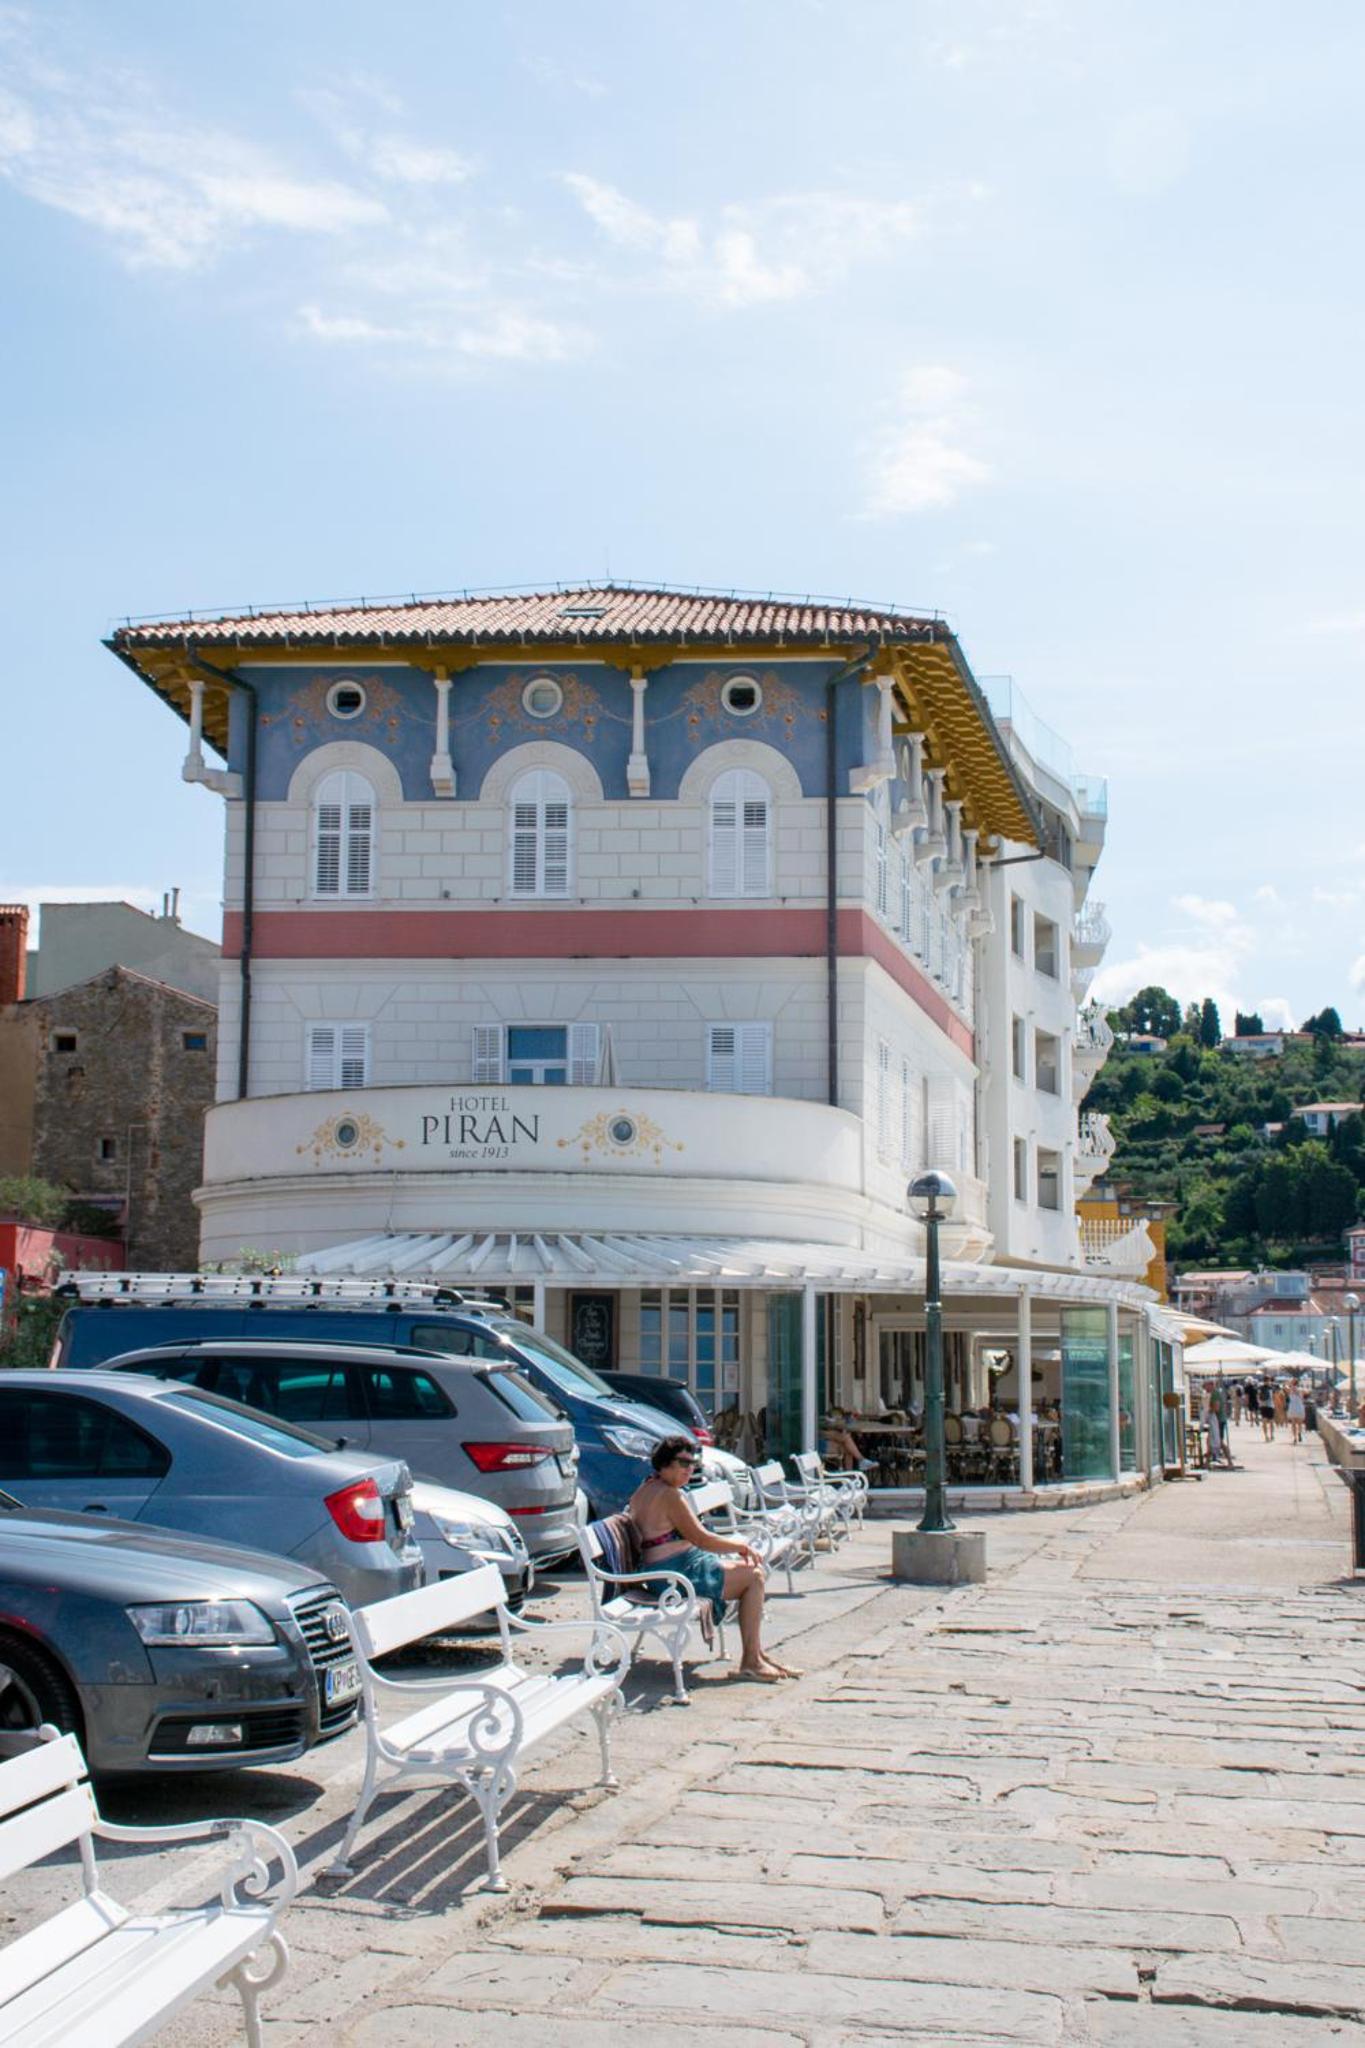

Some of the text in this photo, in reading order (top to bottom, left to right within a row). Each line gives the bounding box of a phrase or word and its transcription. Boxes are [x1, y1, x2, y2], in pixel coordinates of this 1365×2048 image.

[450, 1096, 510, 1112] HOTEL
[422, 1114, 540, 1145] PIRAN
[449, 1146, 509, 1159] since 1913
